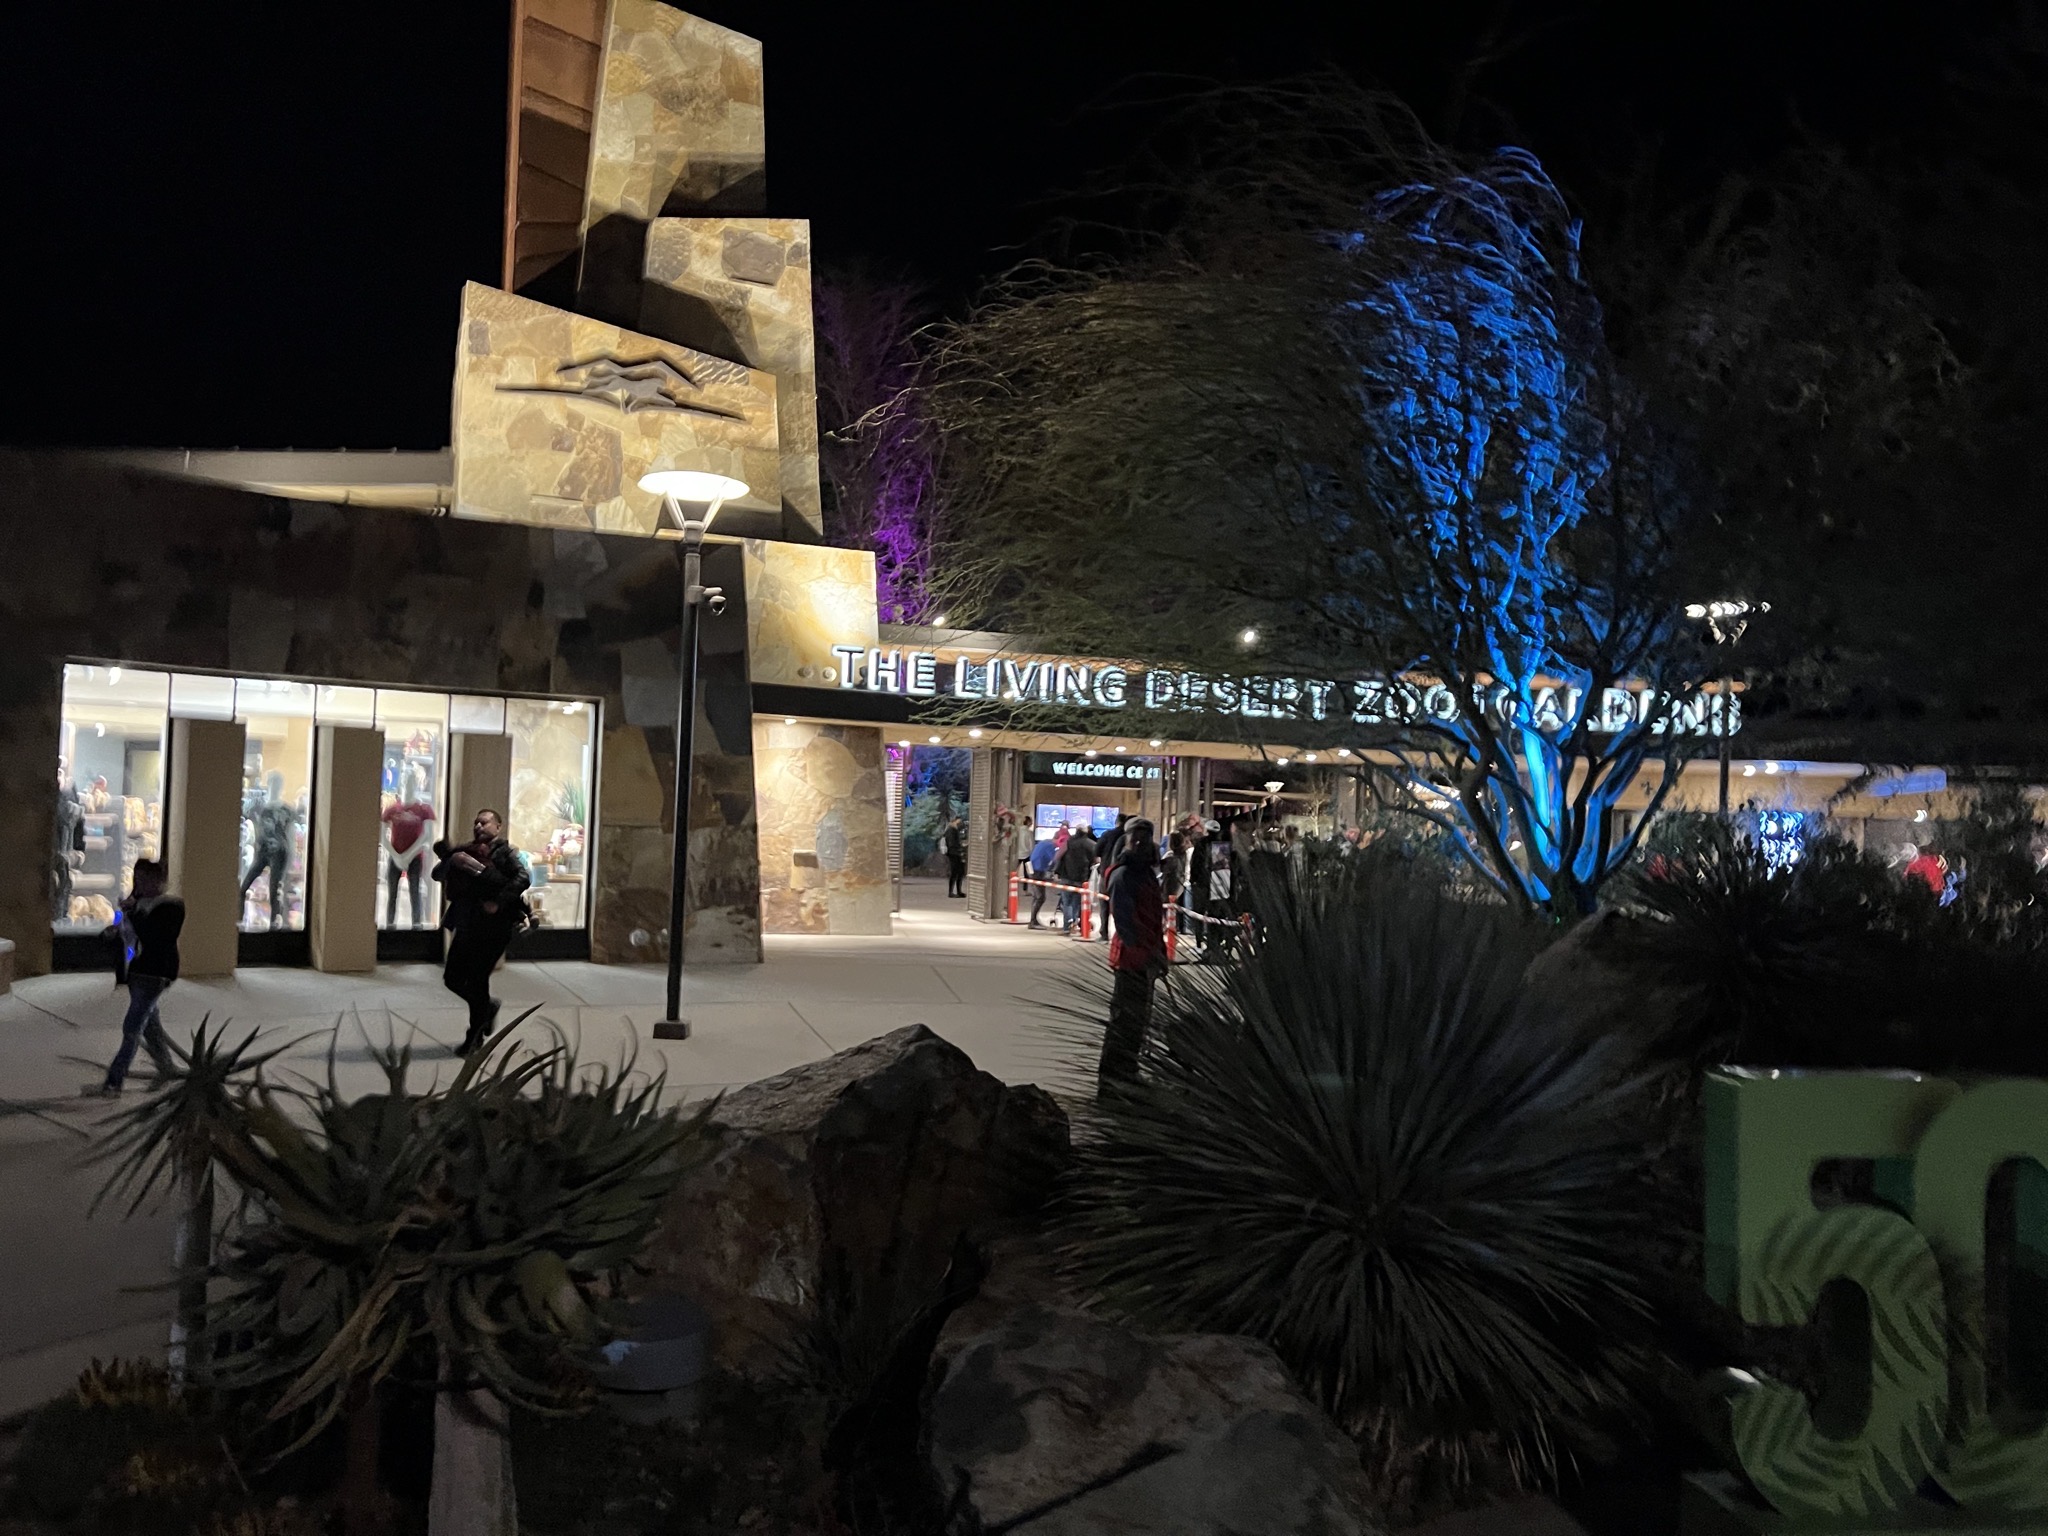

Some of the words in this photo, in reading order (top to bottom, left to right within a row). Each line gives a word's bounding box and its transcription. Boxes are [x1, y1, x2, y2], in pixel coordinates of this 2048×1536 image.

[831, 644, 937, 695] THE
[954, 656, 1127, 708] LIVING
[1145, 668, 1336, 721] DESERT
[1352, 680, 1461, 724] ZOO
[1052, 762, 1124, 778] WELCOME
